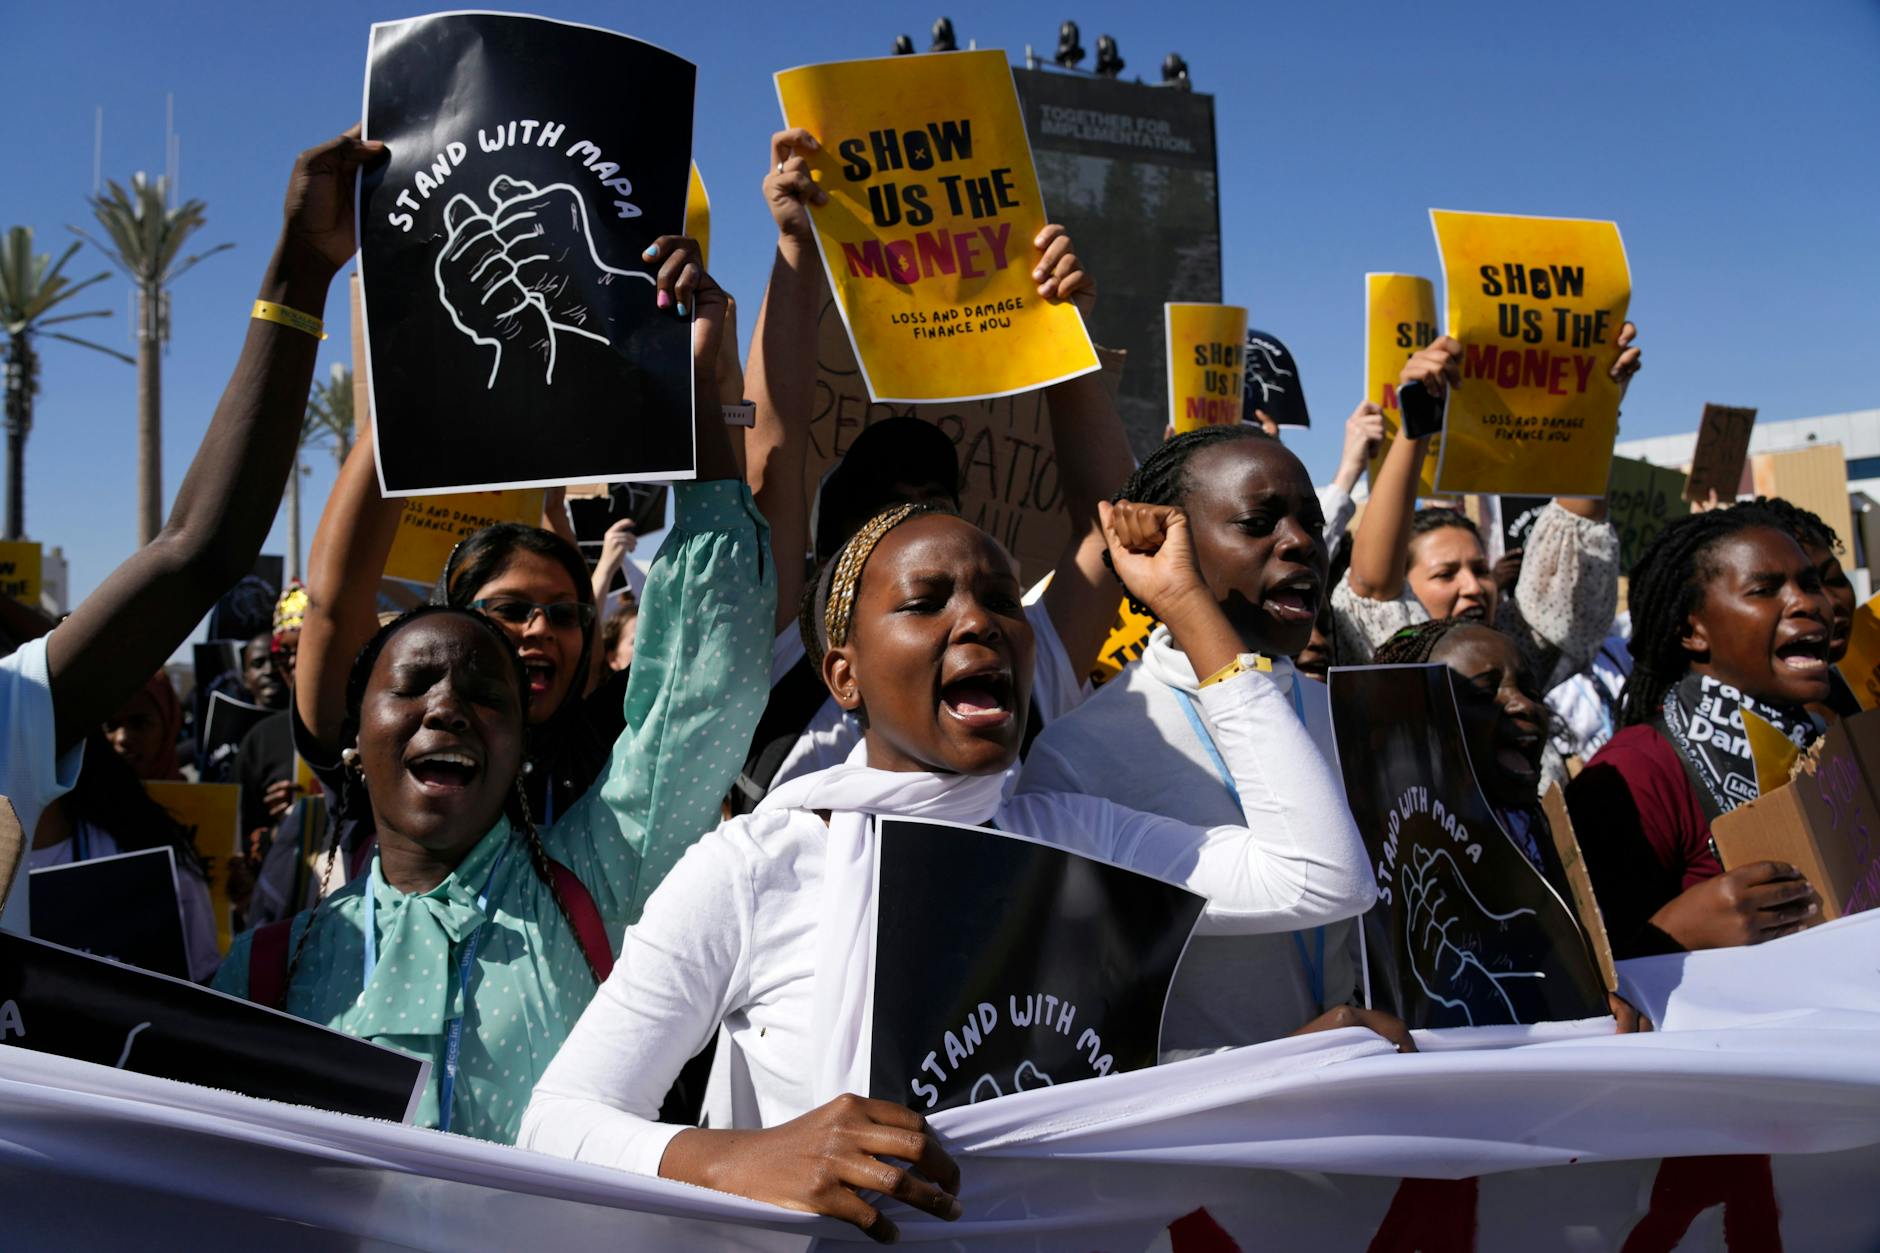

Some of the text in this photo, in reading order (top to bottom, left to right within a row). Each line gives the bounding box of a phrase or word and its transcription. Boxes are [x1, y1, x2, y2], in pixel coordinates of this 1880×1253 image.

[1040, 103, 1170, 135] TOGETHER FOR
[838, 119, 973, 182] SHOW
[388, 119, 643, 232] STAND WITH MAPA
[867, 168, 1020, 227] US THE
[841, 223, 1013, 285] MONEY
[1480, 262, 1585, 300] SHOW
[891, 297, 1024, 325] LOSS AND DAMAGE
[913, 316, 1012, 339] FINANCE NOW
[1498, 303, 1611, 349] US THE
[1396, 321, 1439, 348] SH
[1205, 370, 1229, 396] US
[1464, 343, 1597, 396] MONEY
[1482, 414, 1586, 429] LOSS AND DAMAGE
[1494, 428, 1572, 442] FINANCE NOW
[403, 500, 503, 528] OSS AND DAMAG
[403, 513, 476, 538] FINANCE NO
[1377, 785, 1483, 907] STAND WITH MAPA
[911, 993, 1119, 1108] STAND WITH MA
